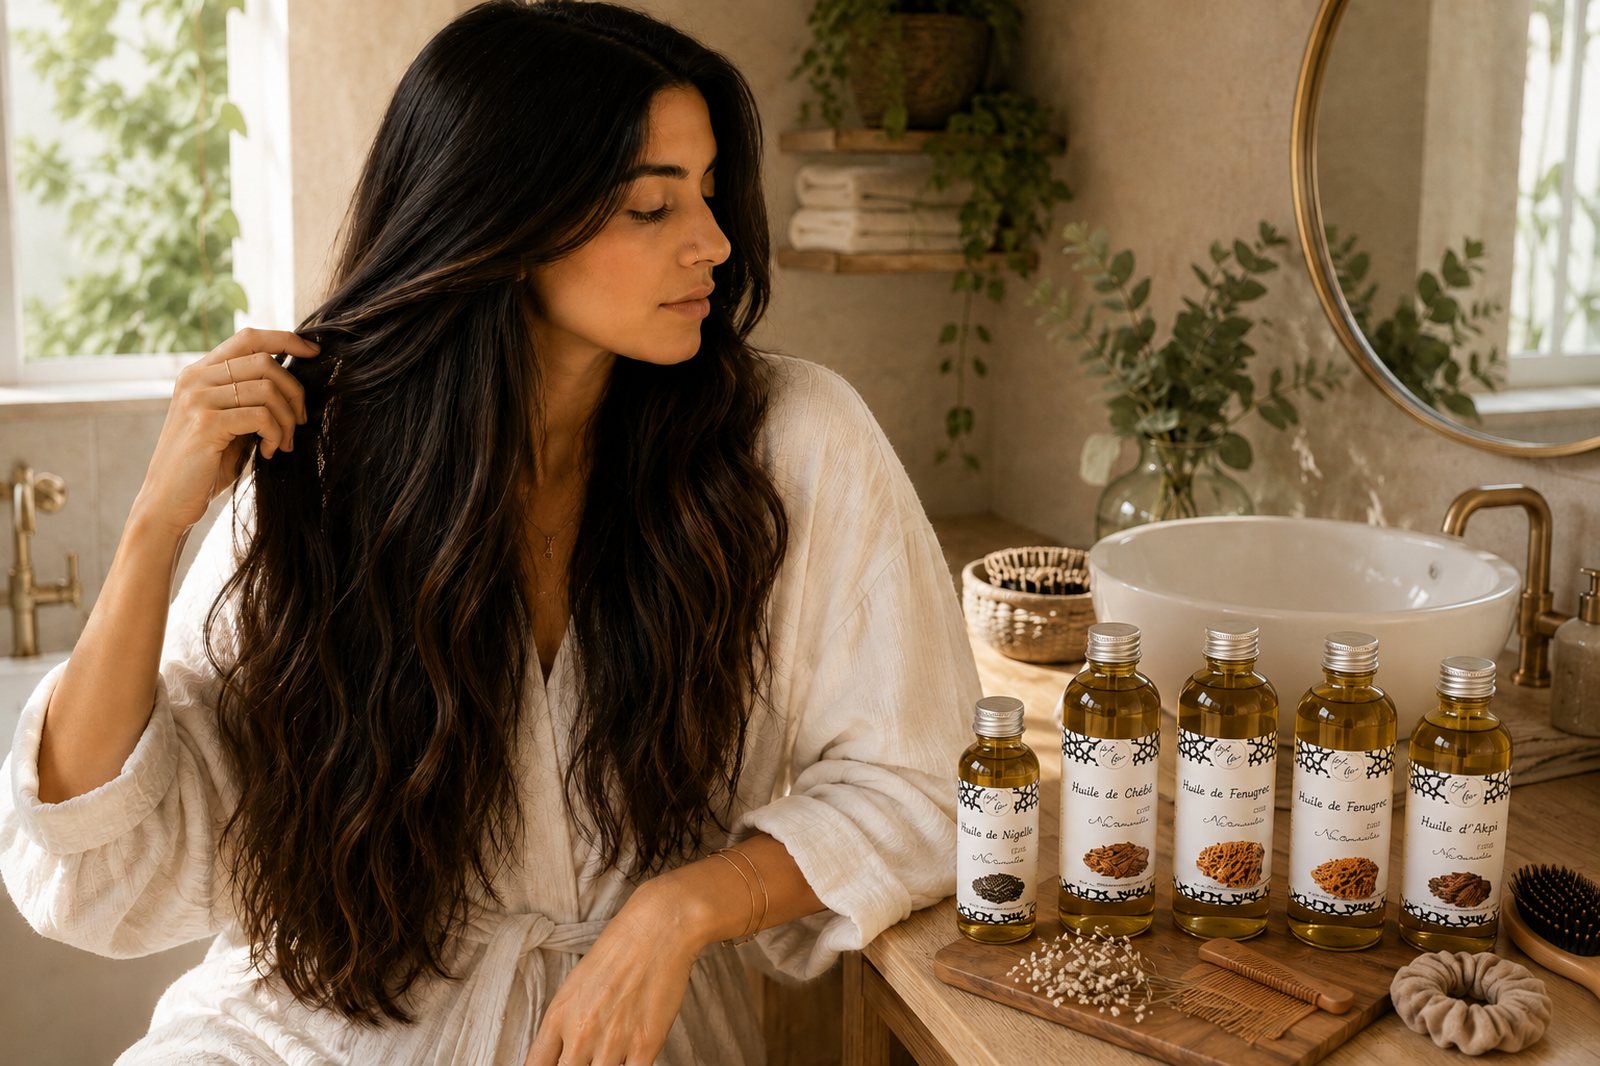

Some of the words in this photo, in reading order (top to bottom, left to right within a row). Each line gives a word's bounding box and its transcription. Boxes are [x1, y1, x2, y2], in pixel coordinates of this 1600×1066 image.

[1071, 781, 1099, 798] Huile
[1105, 788, 1119, 799] de
[1124, 782, 1153, 799] Chébé
[1183, 779, 1205, 796] Huile
[1210, 787, 1223, 799] de
[1229, 785, 1270, 800] Fenugrec
[1298, 791, 1323, 809] Huile
[1328, 800, 1341, 811] de
[1346, 798, 1388, 814] Fenugrec
[960, 821, 982, 838] Huile
[986, 830, 998, 840] de
[1002, 825, 1033, 843] Nigelle
[1421, 815, 1452, 833] Huile
